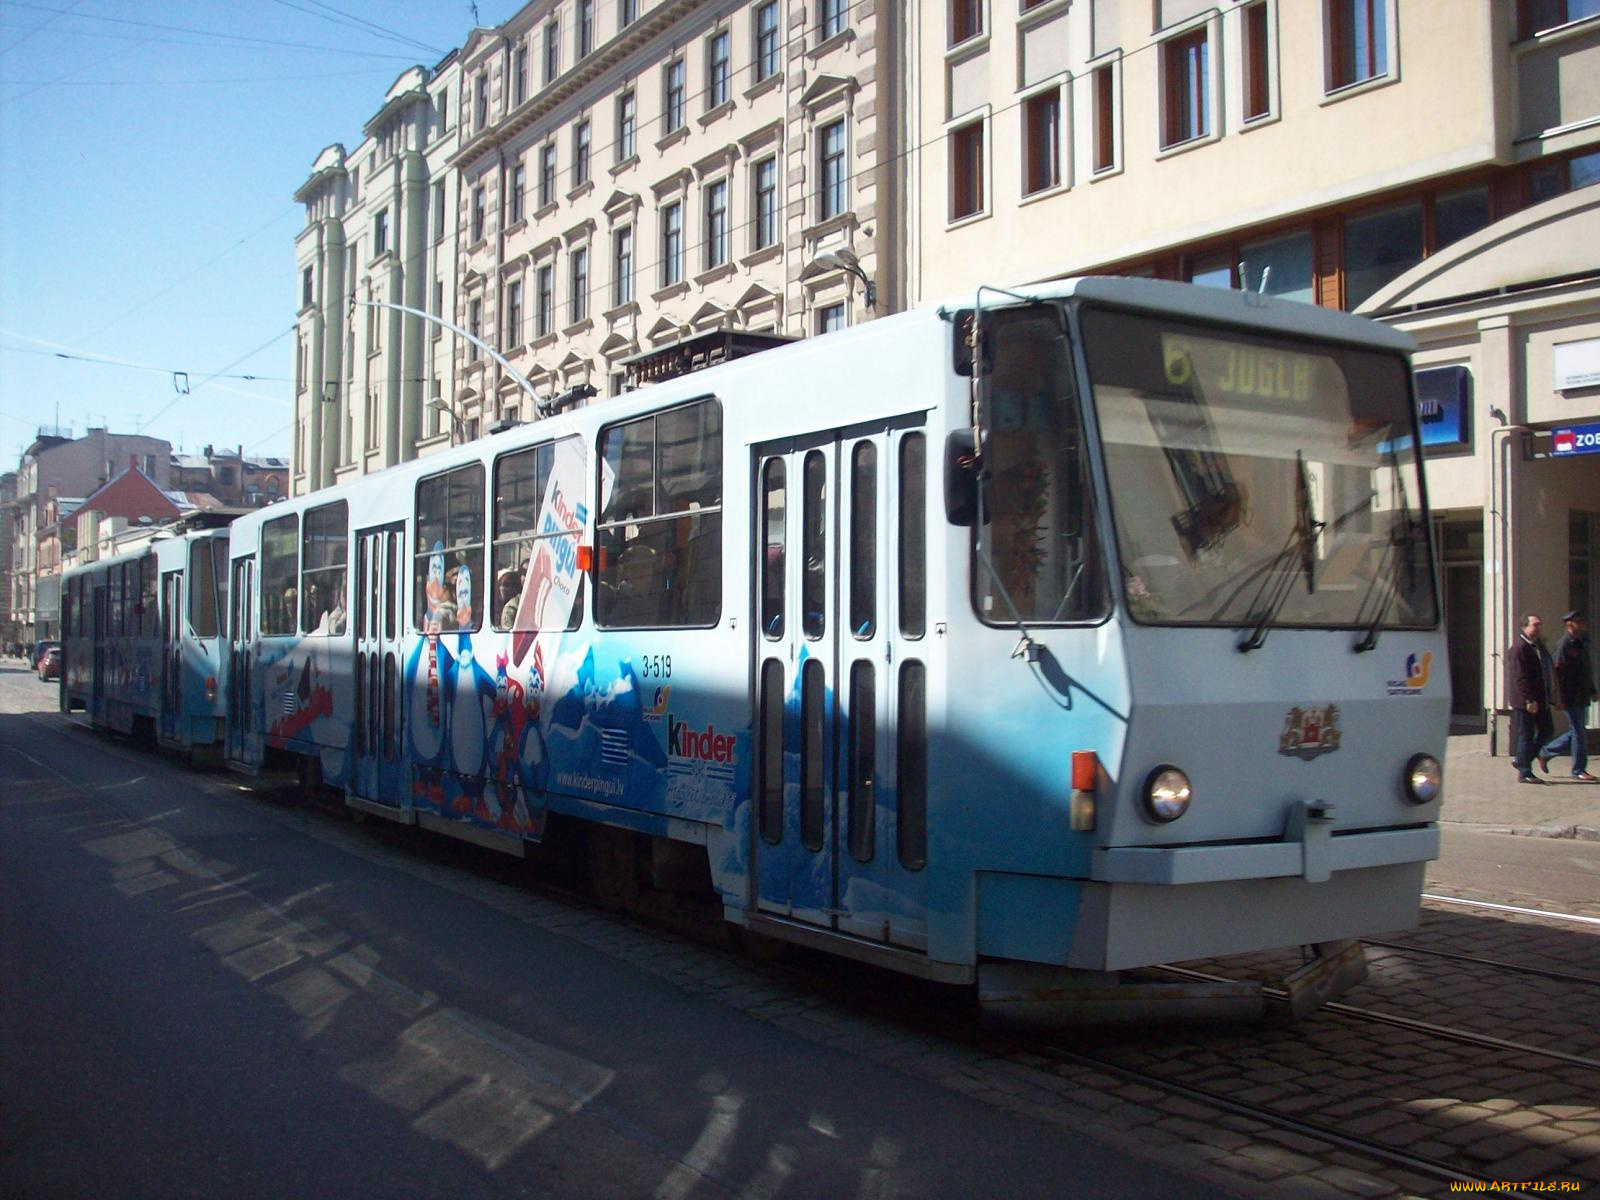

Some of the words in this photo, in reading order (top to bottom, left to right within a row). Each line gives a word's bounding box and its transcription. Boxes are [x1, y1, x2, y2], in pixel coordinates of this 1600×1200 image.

[543, 511, 577, 580] Pingu
[553, 575, 571, 595] Choco
[642, 654, 672, 679] 3-519
